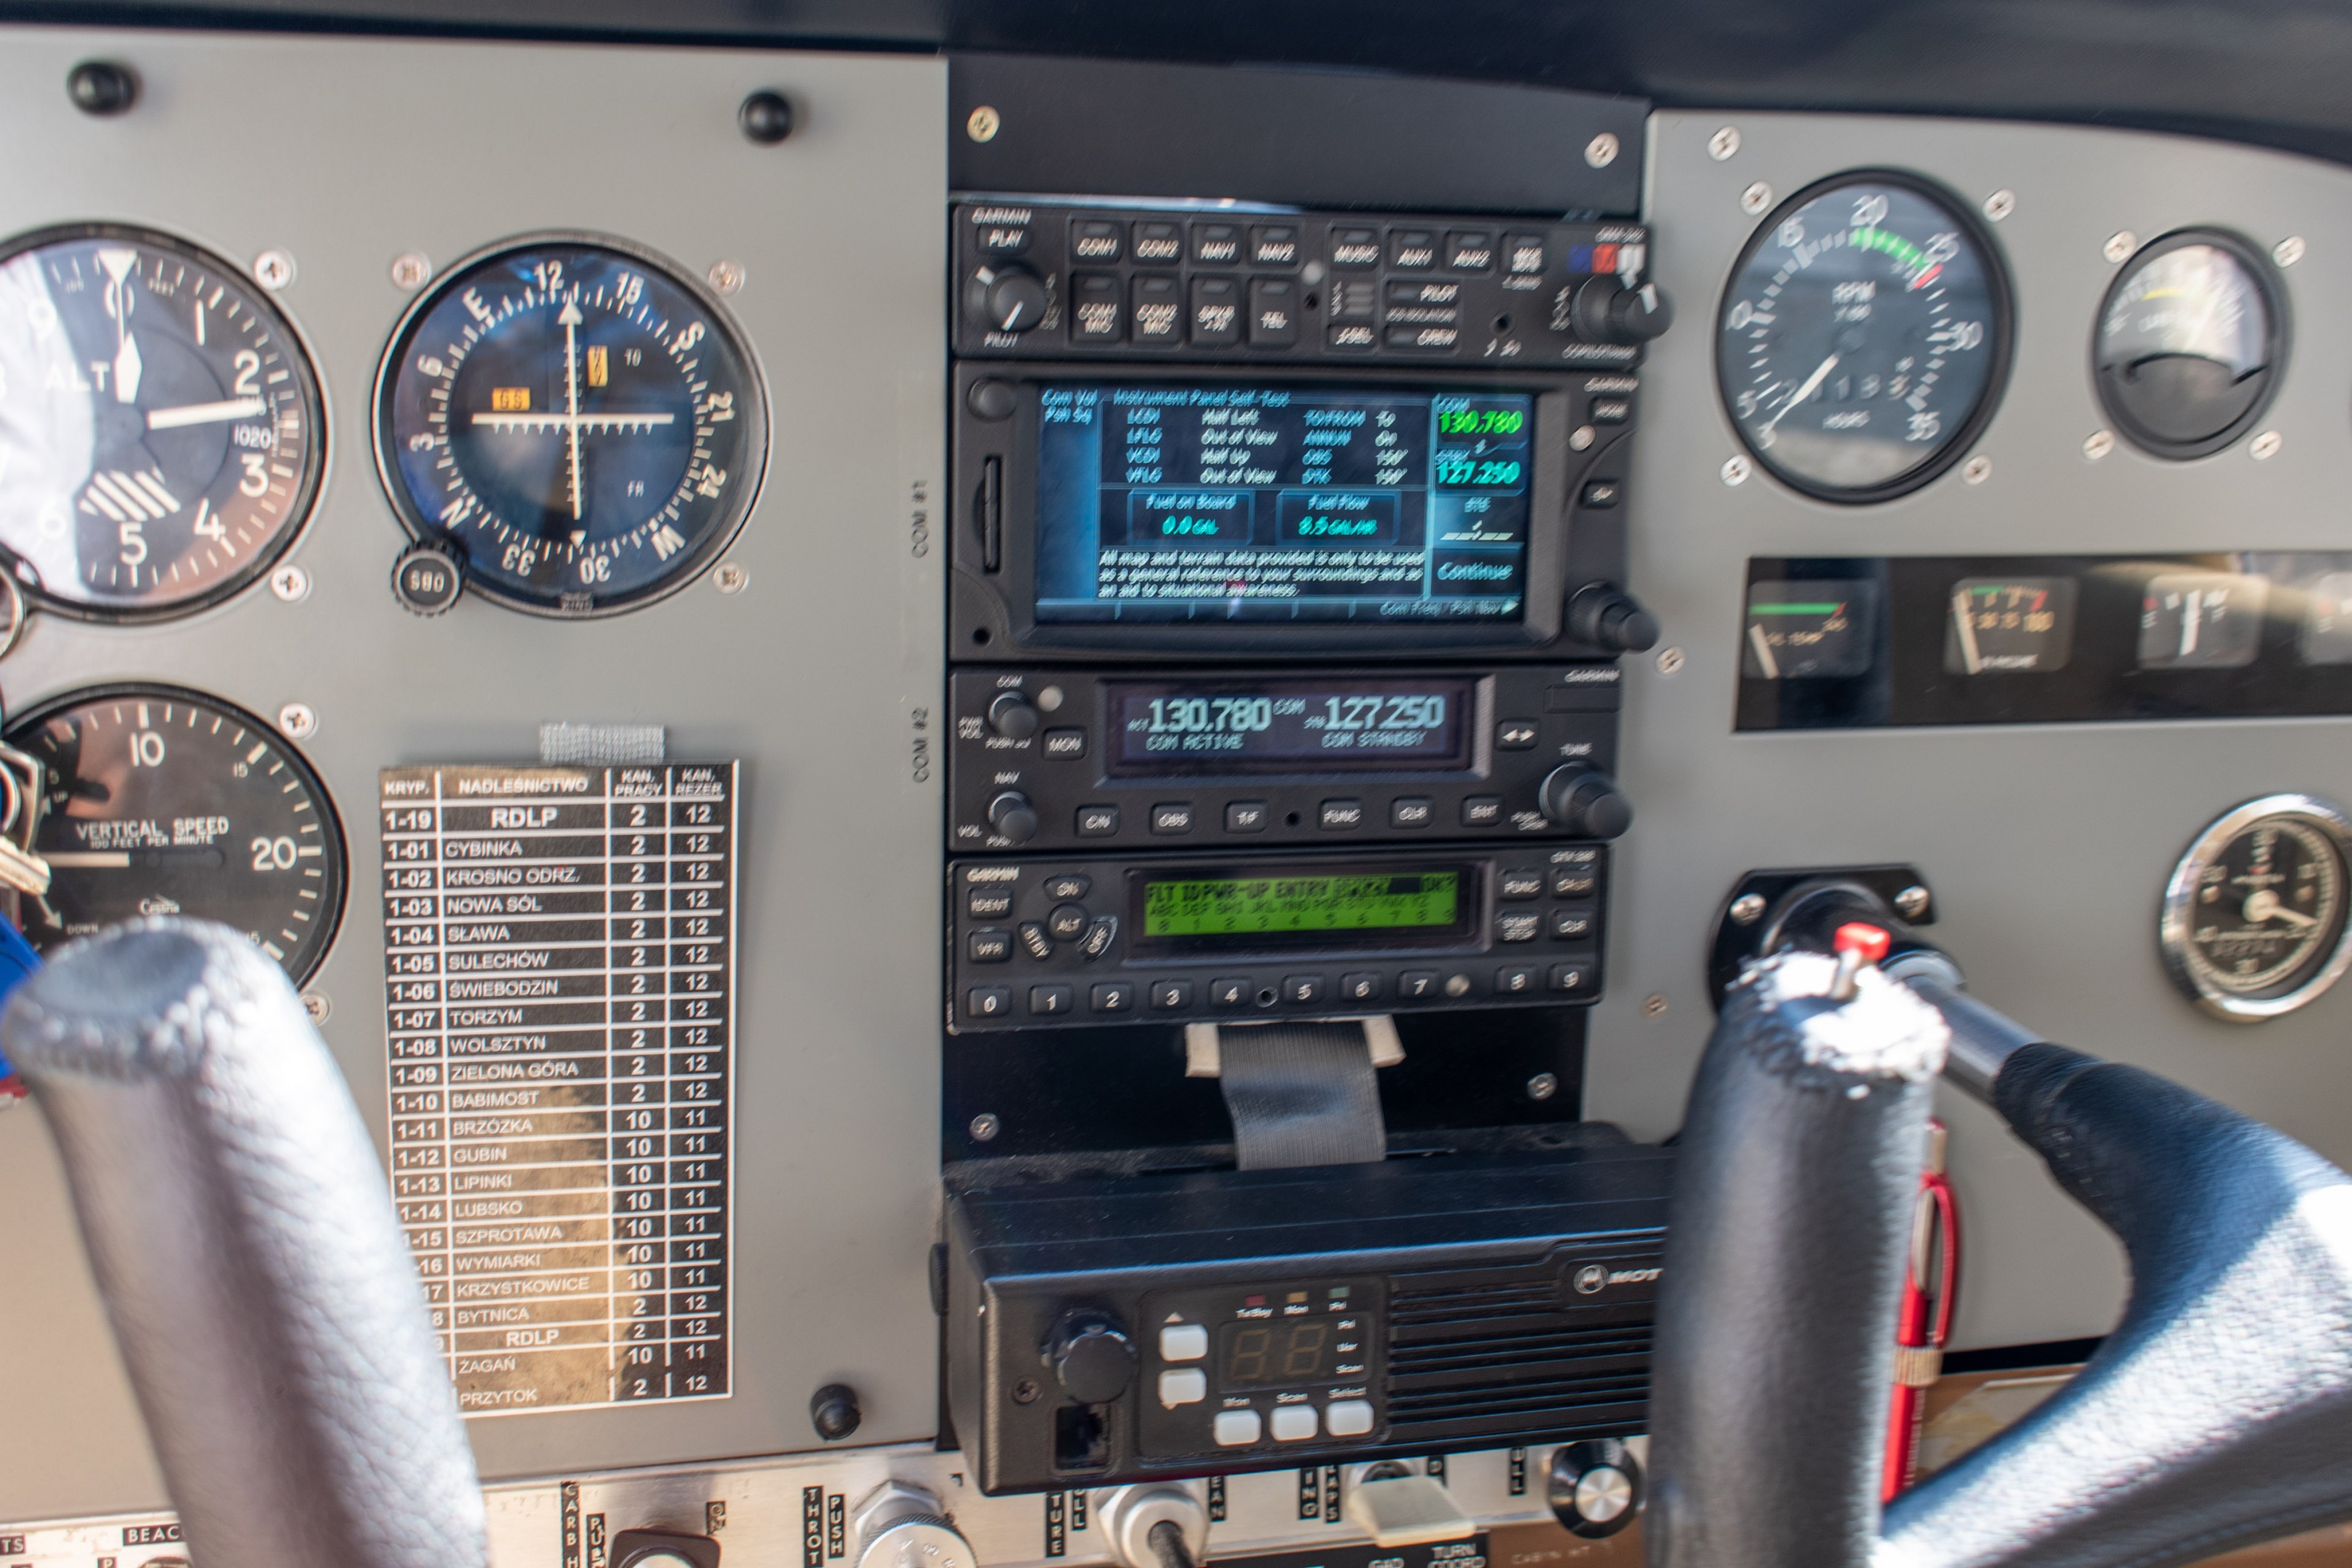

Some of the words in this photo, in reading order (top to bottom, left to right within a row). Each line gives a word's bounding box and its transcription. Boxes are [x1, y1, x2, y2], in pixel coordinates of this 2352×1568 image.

[1850, 194, 1887, 227] 20
[989, 229, 1023, 247] PLAY
[1334, 245, 1379, 264] MUSIC
[533, 259, 565, 290] 12
[617, 271, 645, 305] 15
[462, 287, 491, 322] E
[677, 321, 705, 352] S
[234, 349, 260, 395] 2
[417, 354, 444, 377] 6
[706, 391, 735, 422] 21
[1042, 389, 1073, 406] Com
[1075, 389, 1098, 407] Vol
[1114, 388, 1189, 406] Instrument
[1190, 389, 1228, 407] Panel
[1202, 409, 1231, 425] Half
[1231, 409, 1260, 425] Left
[1439, 410, 1523, 433] 130.780
[234, 424, 271, 449] 1020
[409, 432, 436, 452] 3
[1201, 428, 1228, 445] Out
[1228, 428, 1246, 445] of
[1245, 428, 1278, 445] View
[240, 454, 269, 497] 3
[696, 463, 727, 499] 24
[1436, 461, 1521, 484] 127.250
[1146, 494, 1176, 510] Fuel
[1177, 496, 1195, 510] on
[1197, 494, 1236, 510] Board
[195, 499, 226, 541] 4
[440, 497, 467, 530] N
[120, 521, 147, 565] 5
[652, 523, 685, 561] W
[912, 510, 928, 558] COM
[502, 543, 536, 576] 33
[580, 555, 611, 584] 30
[1437, 562, 1513, 580] Continue
[1098, 584, 1116, 597] an
[1119, 582, 1140, 597] aid
[1142, 583, 1157, 597] to
[1158, 581, 1226, 597] situational
[1148, 697, 1272, 732] 130.780
[131, 732, 165, 767] 10
[1049, 737, 1082, 752] MON
[1146, 734, 1178, 751] COM
[1183, 733, 1244, 750] ACTIVE
[1321, 732, 1355, 748] COM
[1357, 731, 1427, 747] STANDBY
[234, 763, 248, 777] 15
[912, 737, 929, 783] COM
[460, 776, 589, 794] NADLEŚNICTWO
[615, 784, 661, 797] PRACY
[54, 791, 68, 803] UP
[386, 809, 431, 830] 1-19
[491, 807, 558, 828] RDLP
[630, 804, 646, 827] 2
[686, 804, 711, 823] 12
[1323, 809, 1360, 825] FUNC
[75, 820, 163, 841] VERTICAL
[173, 816, 229, 835] SPEED
[90, 838, 109, 849] 100
[113, 837, 141, 848] FEET
[148, 836, 168, 846] PER
[174, 835, 213, 845] MINUTE
[388, 838, 429, 859] 1-01
[446, 839, 523, 857] CYBINKA
[631, 835, 645, 854] 2
[687, 835, 710, 852] 12
[251, 836, 297, 871] 20
[389, 868, 431, 888] 1-02
[446, 869, 520, 886] KROSNO
[526, 867, 581, 884] ODRZ.
[632, 864, 645, 883] 2
[687, 862, 710, 880] 12
[967, 867, 1019, 882] GARMIN
[1504, 880, 1540, 894] FUNC
[139, 897, 179, 915] Cessna
[390, 897, 432, 917] 1-03
[447, 897, 503, 914] NOWA
[507, 894, 542, 912] SÓL
[632, 891, 645, 910] 2
[687, 890, 709, 907] 12
[971, 899, 1008, 912] IDENT
[391, 926, 433, 945] 1-04
[448, 925, 510, 942] SŁAWA
[632, 919, 645, 939] 2
[687, 918, 709, 935] 12
[393, 954, 433, 973] 1-05
[449, 950, 550, 970] SULECHÓW
[393, 982, 435, 1001] 1-06
[449, 979, 558, 999] ŚWIEBODZIN
[1355, 980, 1370, 997] 6
[1414, 979, 1429, 995] 7
[1510, 973, 1525, 990] 8
[1564, 971, 1578, 988] 9
[1047, 993, 1057, 1010] 1
[1106, 991, 1120, 1008] 2
[1165, 989, 1180, 1006] 3
[1225, 987, 1238, 1003] 4
[1298, 983, 1312, 1000] 5
[984, 995, 997, 1013] 0
[394, 1010, 436, 1029] 1-07
[450, 1008, 523, 1026] TORZYM
[396, 1037, 436, 1057] 1-08
[452, 1035, 546, 1053] WOLSZTYN
[395, 1065, 437, 1083] 1-09
[452, 1063, 523, 1081] ZIELONA
[529, 1061, 579, 1078] GÓRA
[396, 1093, 438, 1111] 1-10
[452, 1090, 539, 1108] BABIMOST
[397, 1121, 437, 1140] 1-11
[399, 1148, 439, 1167] 1-12
[454, 1146, 507, 1163] GUBIN
[399, 1175, 440, 1193] 1-13
[454, 1173, 513, 1191] LIPINKI
[400, 1202, 441, 1220] 1-14
[455, 1199, 523, 1217] LUBSKO
[403, 1229, 442, 1247] 1-15
[456, 1225, 563, 1244] SZPROTAWA
[414, 1257, 443, 1274] -16
[457, 1253, 541, 1271] WYMIARKI
[457, 1277, 590, 1298] KRZYSTKOWICE
[458, 1307, 530, 1324] BYTNICA
[507, 1330, 559, 1347] RDLP
[459, 1356, 515, 1374] ŻAGAŃ
[460, 1389, 538, 1406] PRZYTOK
[1276, 1392, 1308, 1403] Scan
[1328, 1387, 1366, 1399] Select
[128, 1526, 179, 1543] BEAC
[807, 1489, 822, 1564] THROT
[830, 1497, 842, 1554] PUSH
[1051, 1495, 1062, 1553] TURE
[1431, 1544, 1477, 1559] TURN
